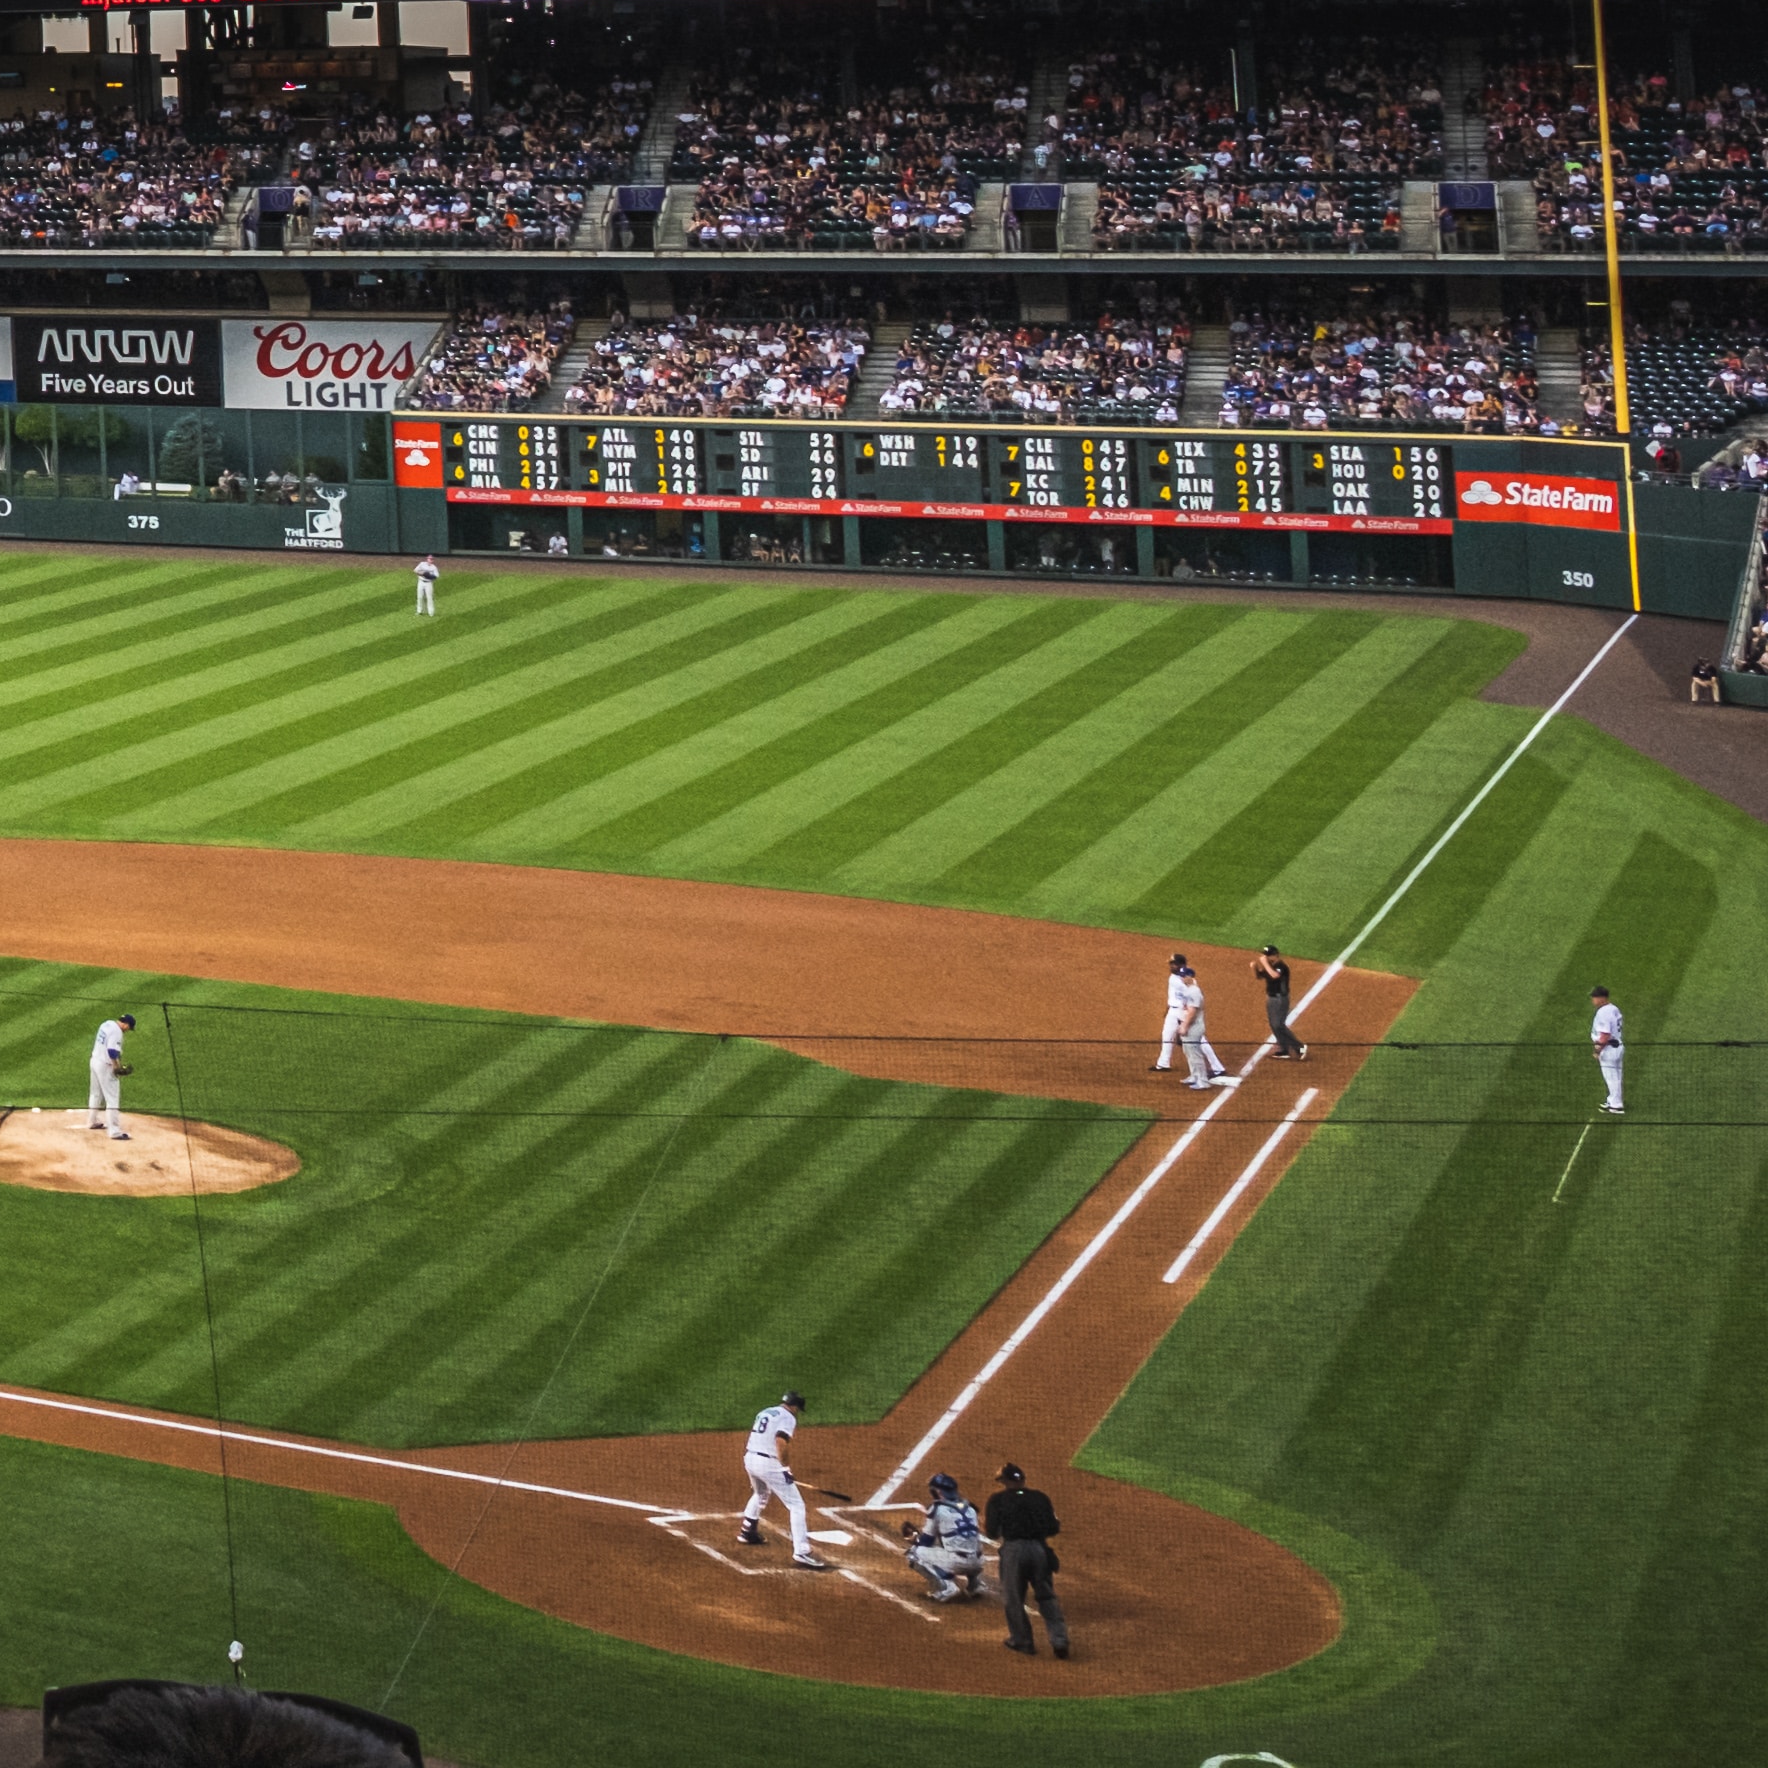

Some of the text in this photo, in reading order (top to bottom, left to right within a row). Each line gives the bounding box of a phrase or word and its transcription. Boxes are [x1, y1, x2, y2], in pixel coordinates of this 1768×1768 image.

[37, 329, 194, 364] ARROW
[254, 322, 415, 381] Coors
[41, 373, 195, 396] Five Years Out
[286, 381, 389, 409] LIGHT
[468, 425, 498, 439] CHC
[603, 428, 627, 442] ATL
[739, 431, 764, 446] STL
[395, 439, 439, 449] StateFarm
[469, 441, 497, 455] CIN
[880, 435, 915, 449] WSH
[1025, 438, 1052, 453] CLE
[603, 444, 636, 459] NYM
[741, 448, 760, 462] SD
[1175, 442, 1206, 457] TEX
[1330, 446, 1363, 460] SEA
[469, 459, 494, 472] PHI
[880, 452, 907, 466] DET
[1026, 456, 1054, 471] BAL
[608, 462, 631, 476] PIT
[1176, 459, 1195, 474] TB
[1333, 464, 1365, 478] HOU
[1178, 478, 1212, 493] MIN
[1333, 483, 1369, 499] OAK
[1505, 482, 1612, 513] StateFarm
[127, 515, 159, 529] 375
[1104, 512, 1152, 521] StateFarm
[285, 528, 305, 538] THE
[285, 538, 344, 549] HARTFORD
[1563, 570, 1594, 588] 350
